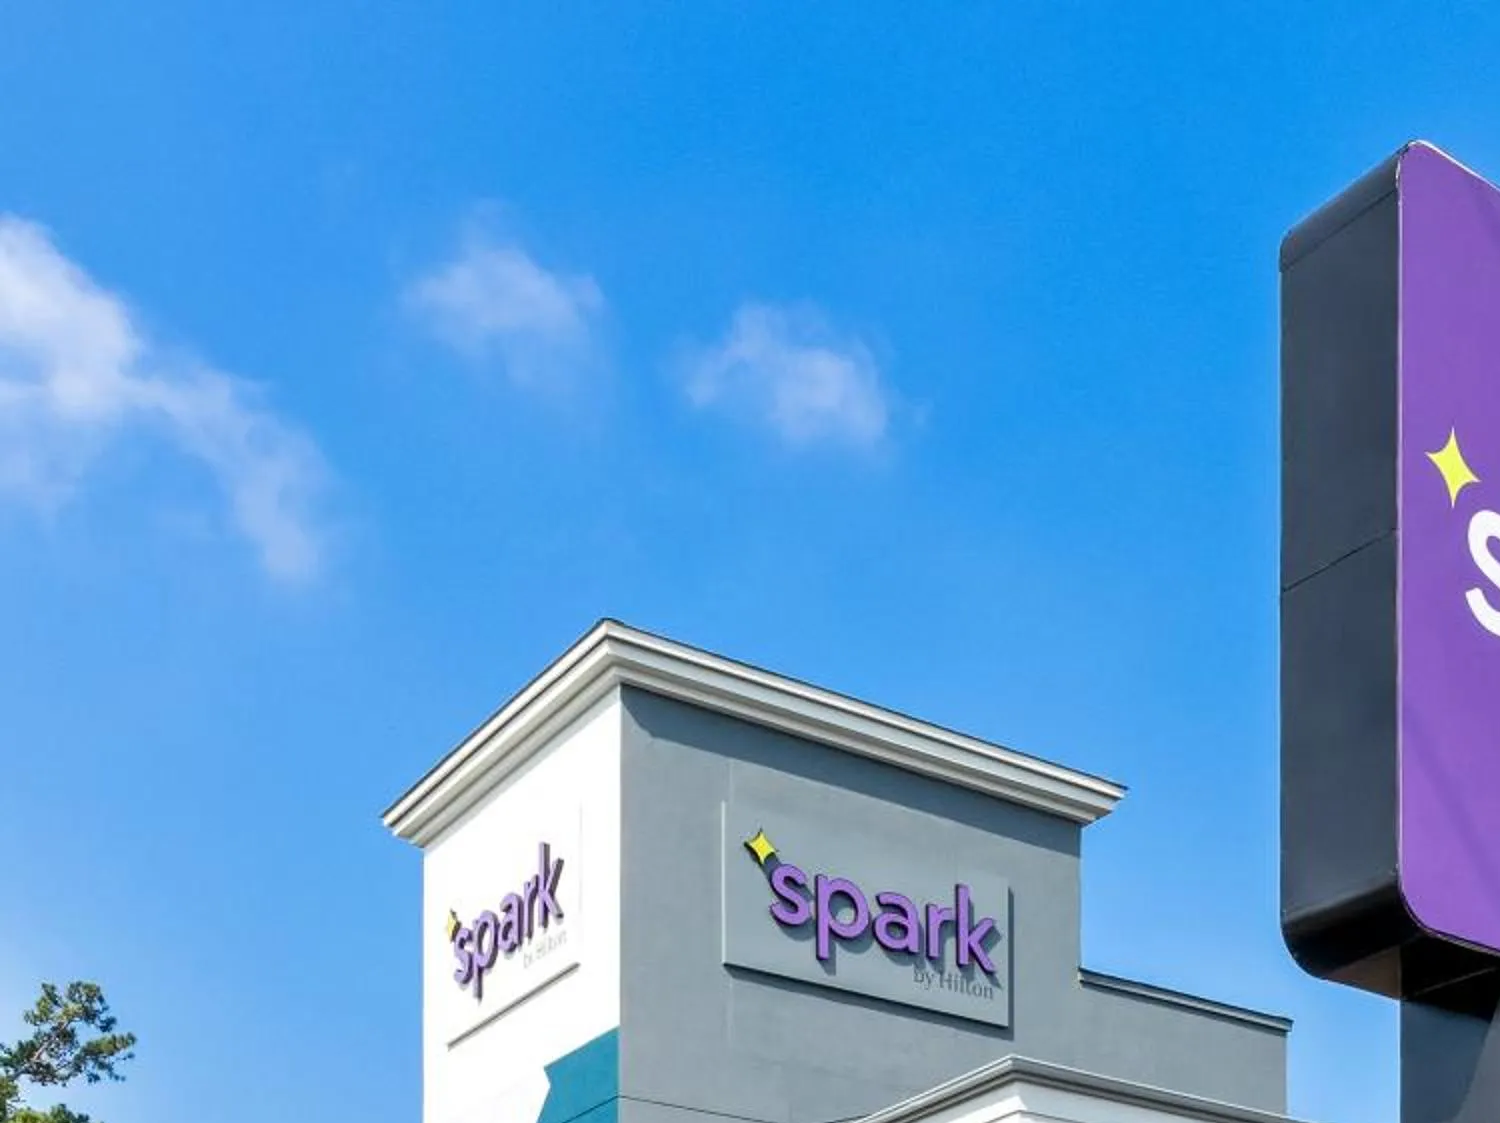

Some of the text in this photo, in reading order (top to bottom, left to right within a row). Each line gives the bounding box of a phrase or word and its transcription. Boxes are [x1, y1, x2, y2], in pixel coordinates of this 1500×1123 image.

[453, 841, 565, 1002] spark
[769, 863, 997, 976] spark
[913, 963, 994, 1000] by Hilton
